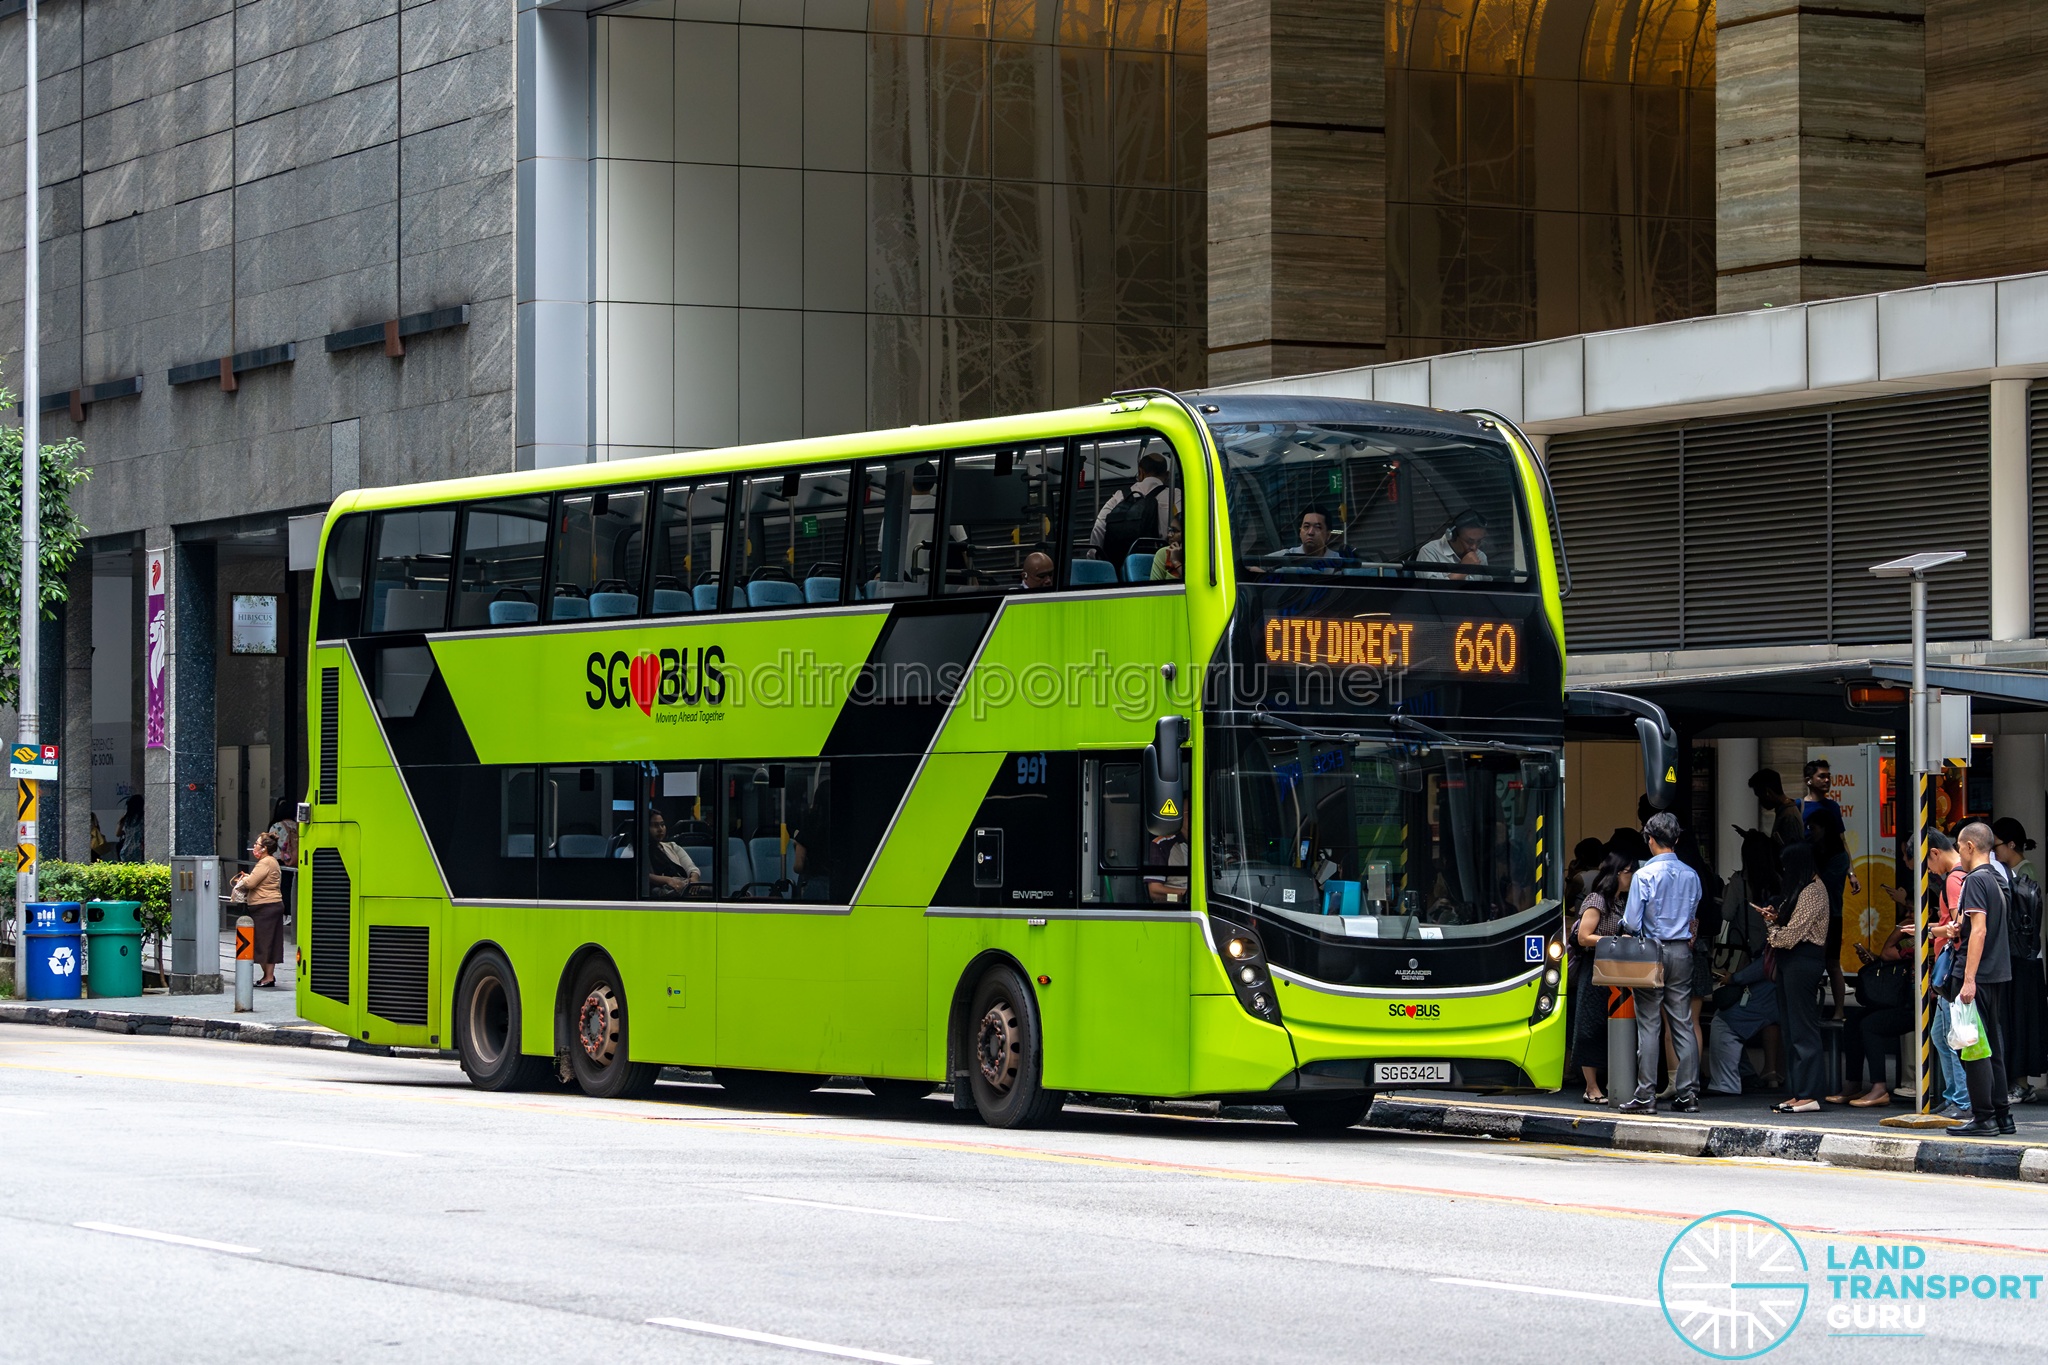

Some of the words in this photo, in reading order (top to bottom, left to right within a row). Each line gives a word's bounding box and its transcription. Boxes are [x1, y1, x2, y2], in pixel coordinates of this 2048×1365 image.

[1266, 618, 1322, 662] CITY
[1327, 621, 1413, 666] DIRECT
[1455, 622, 1516, 673] 660
[656, 712, 678, 725] Moving
[678, 711, 698, 722] Ahead
[699, 710, 725, 724] Together
[1831, 774, 1855, 787] URAL
[20, 825, 27, 836] 4
[1381, 1066, 1445, 1080] SG6342L
